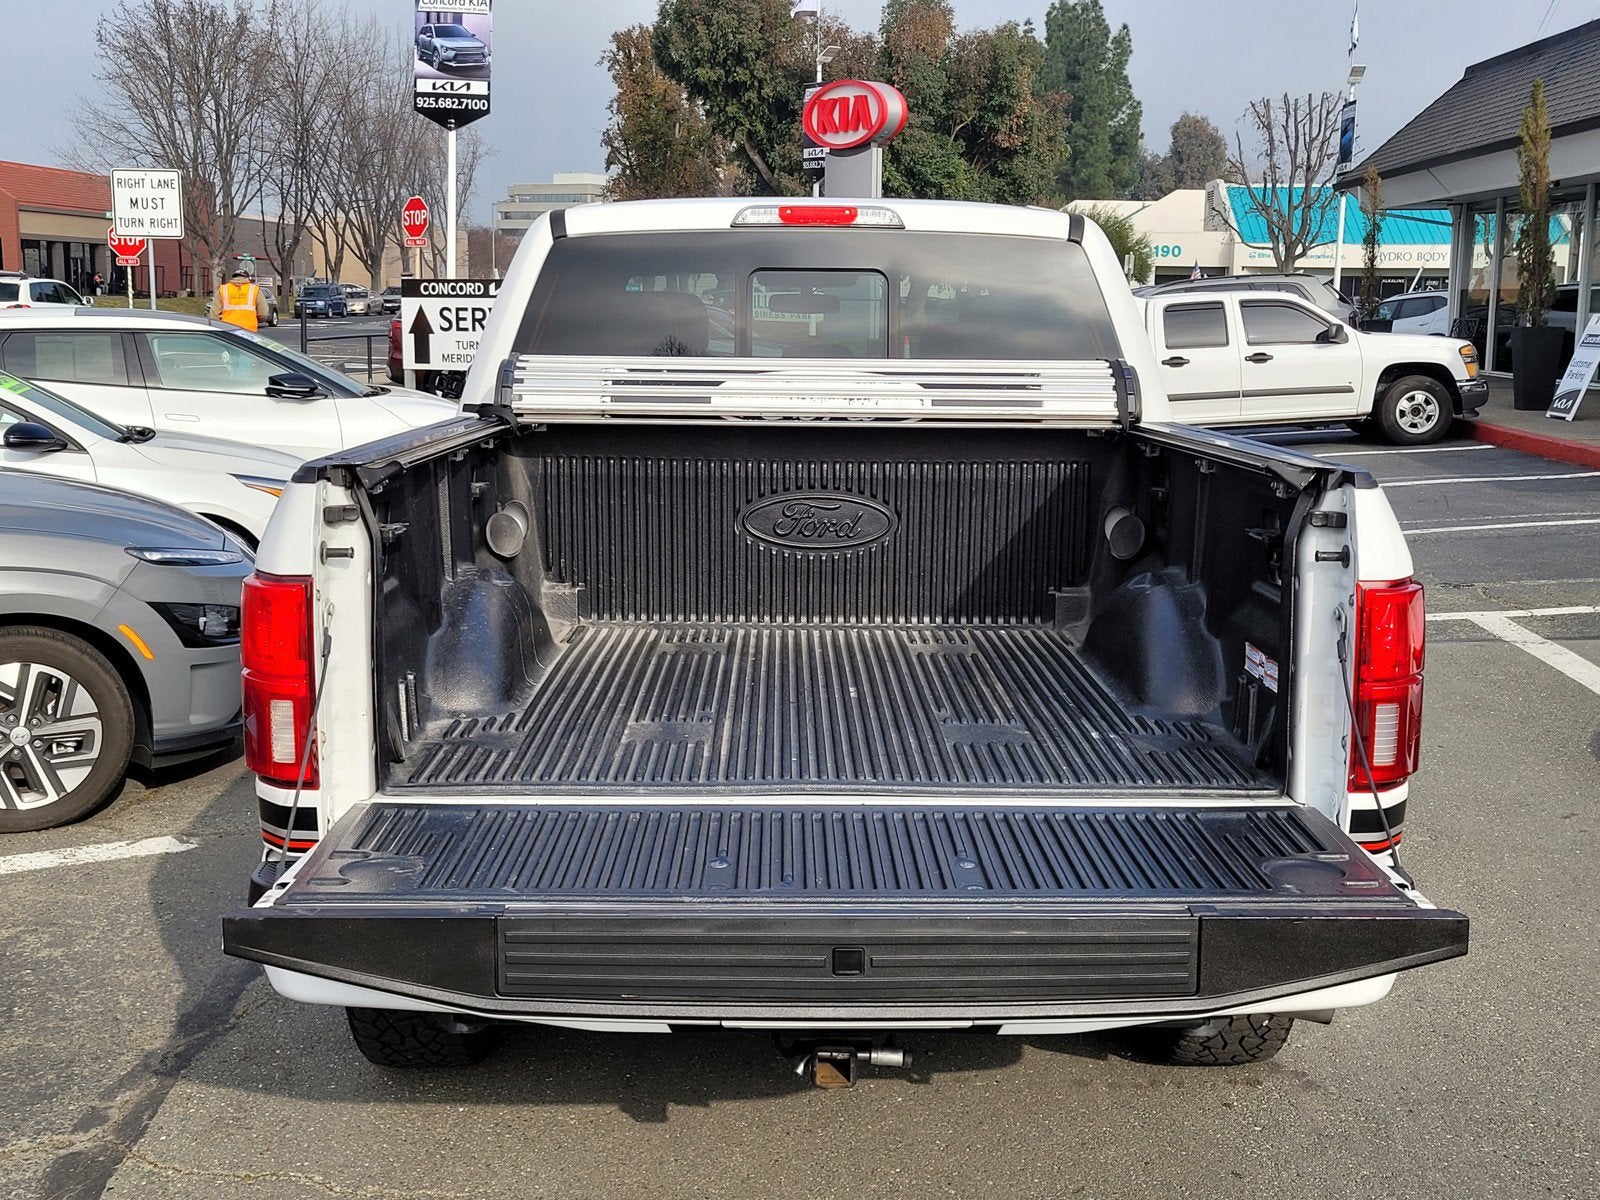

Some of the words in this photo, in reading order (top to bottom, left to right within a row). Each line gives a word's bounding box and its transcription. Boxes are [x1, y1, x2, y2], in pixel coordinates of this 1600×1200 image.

[432, 81, 471, 92] KIA
[416, 97, 488, 110] 925.682.7100
[815, 94, 873, 134] KIA
[117, 178, 145, 188] RIGHT
[151, 178, 176, 189] LANE
[129, 197, 165, 210] MUST
[118, 217, 144, 228] TURN
[150, 218, 178, 229] RIGHT
[404, 210, 427, 226] STOP
[1149, 245, 1182, 257] 190
[1417, 252, 1448, 261] BODY
[420, 282, 485, 295] CONCORD
[439, 306, 493, 332] SER
[754, 310, 786, 319] SINESS
[773, 502, 863, 538] Ford
